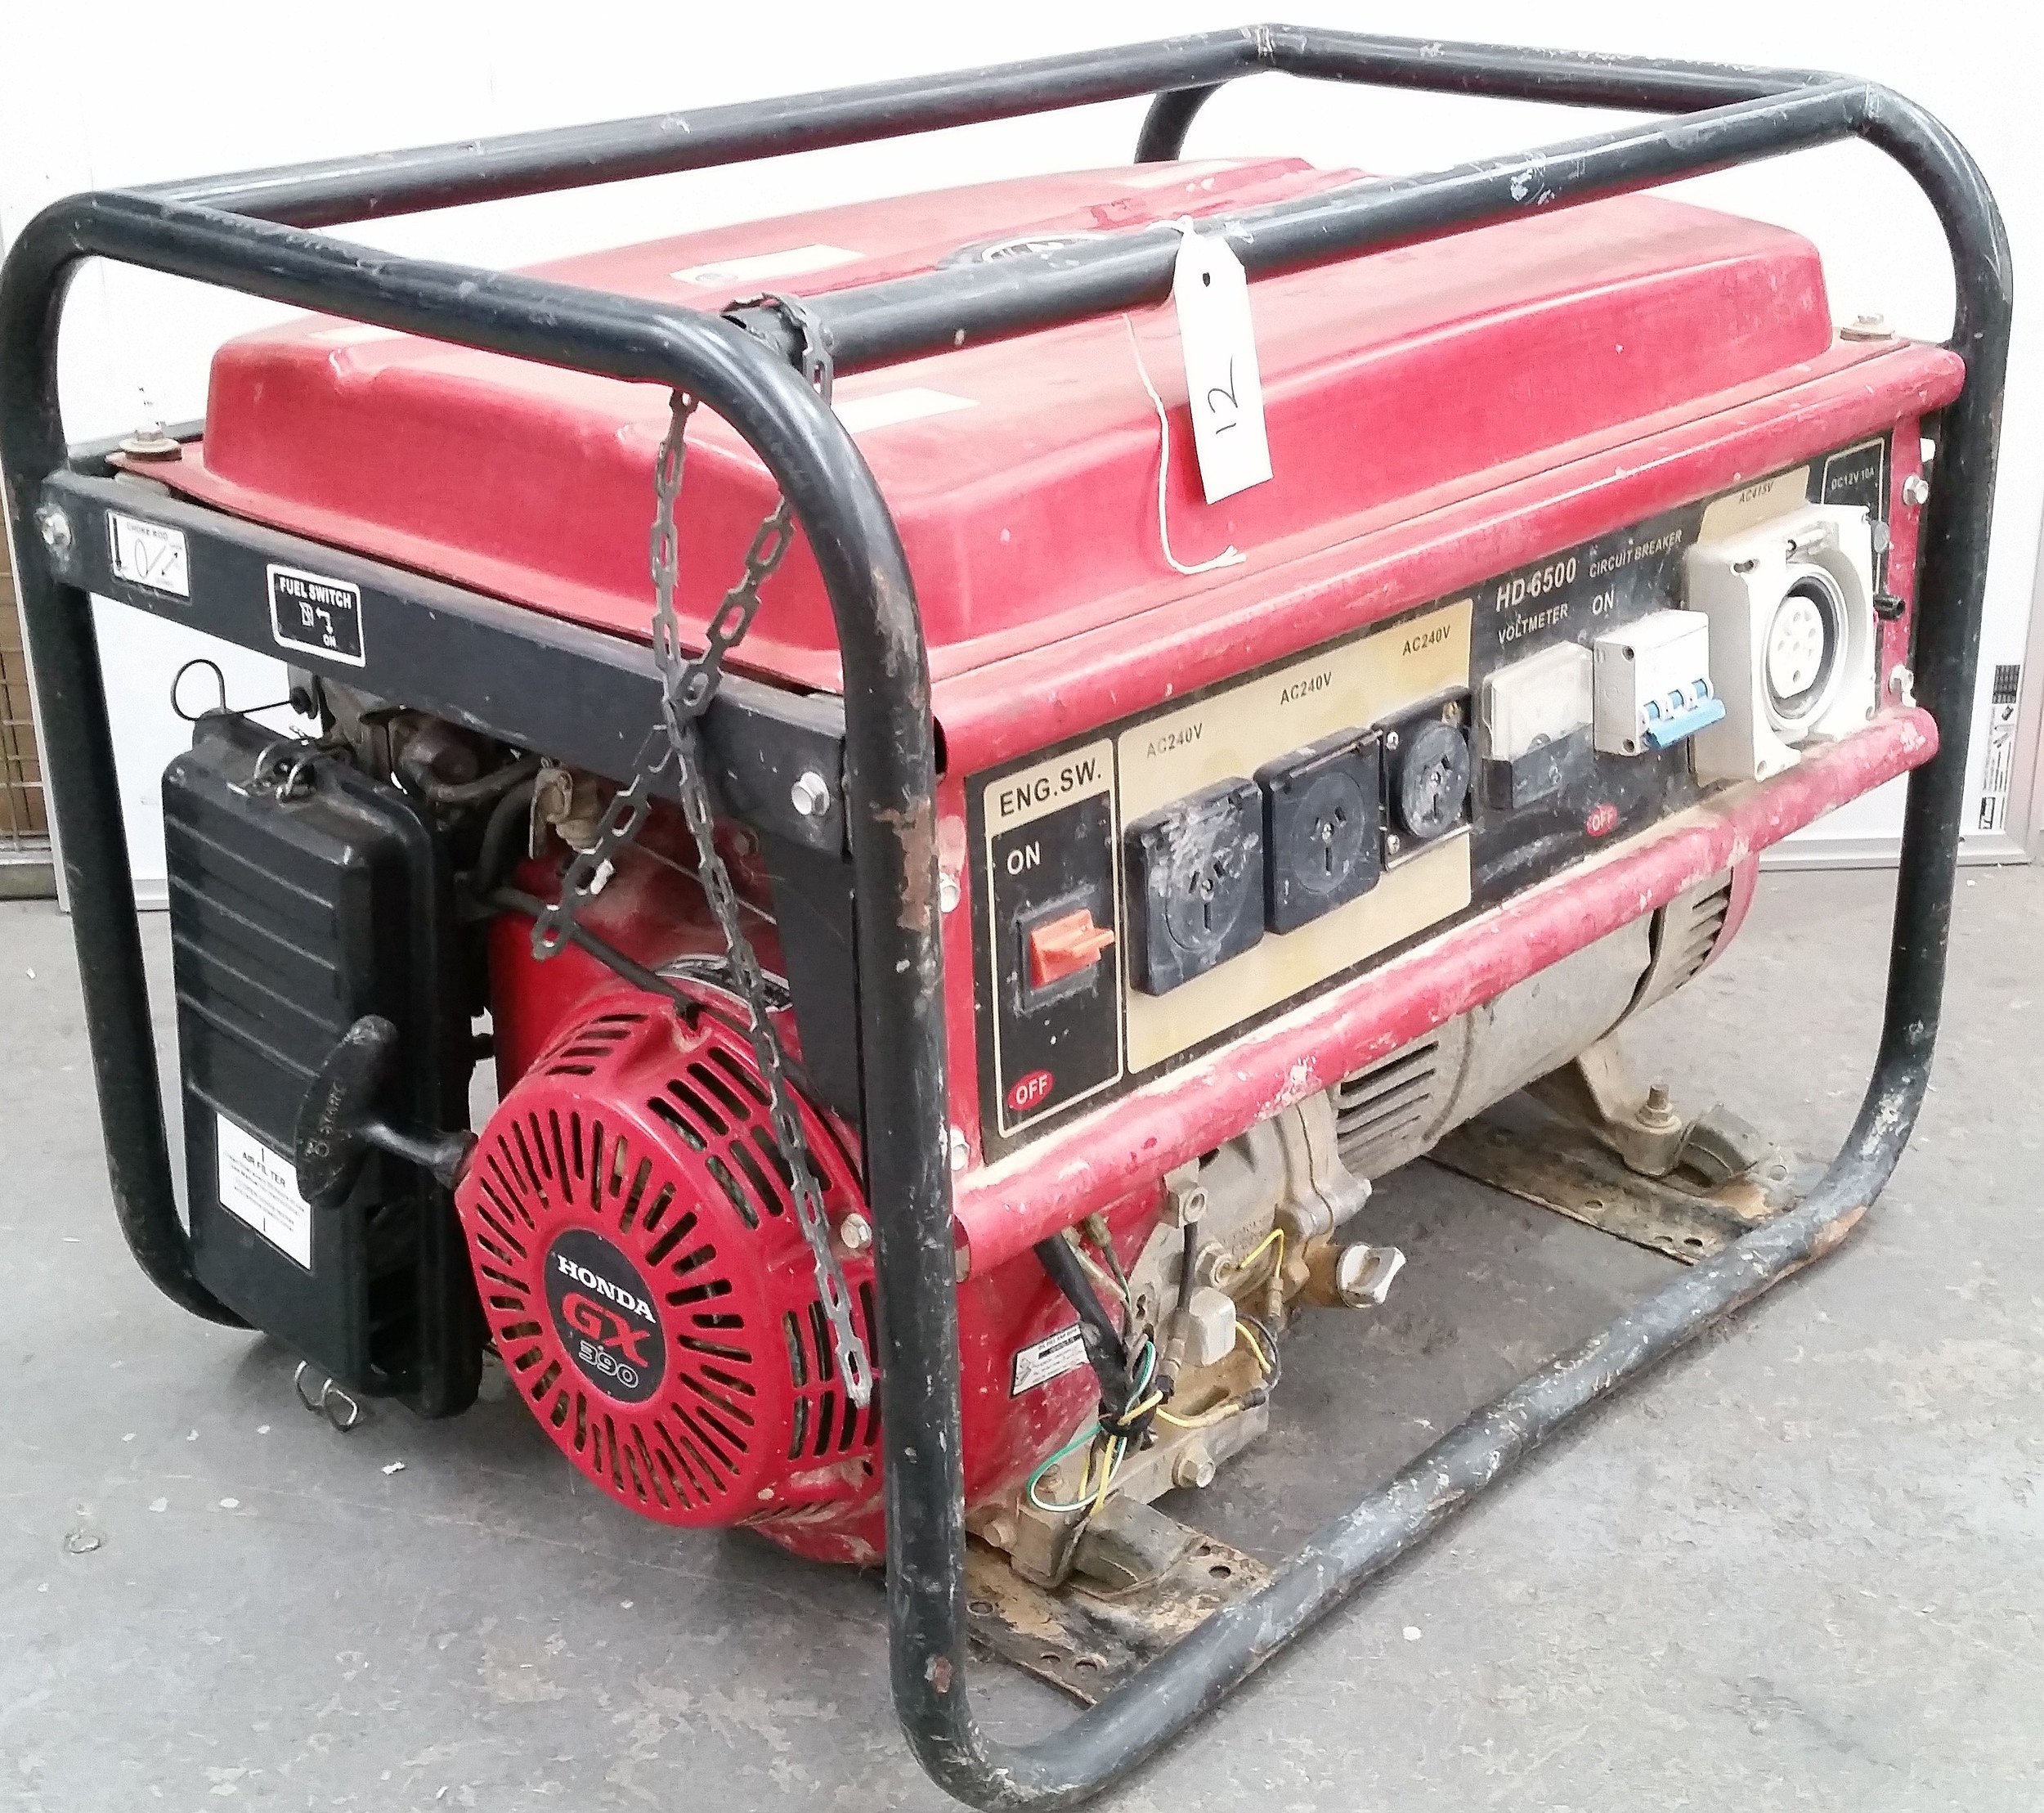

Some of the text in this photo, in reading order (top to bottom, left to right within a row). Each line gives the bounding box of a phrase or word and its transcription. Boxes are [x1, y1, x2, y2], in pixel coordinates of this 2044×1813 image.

[1208, 354, 1238, 434] 12
[1589, 529, 1683, 578] CIRCUIT BREAKER
[280, 577, 352, 609] FUEL SWITCH
[1592, 590, 1615, 615] ON
[323, 634, 336, 647] ON
[1402, 625, 1450, 656] AC240V
[1498, 603, 1568, 644] VOLTMETER
[1280, 671, 1333, 705] AC240V
[1146, 723, 1204, 758] AC240V
[1000, 758, 1102, 817] ENG.SW.
[1006, 841, 1041, 875] ON
[1015, 1075, 1049, 1105] OFF
[558, 1254, 657, 1324] HONDA
[563, 1292, 651, 1368] GX
[579, 1340, 639, 1389] 390
